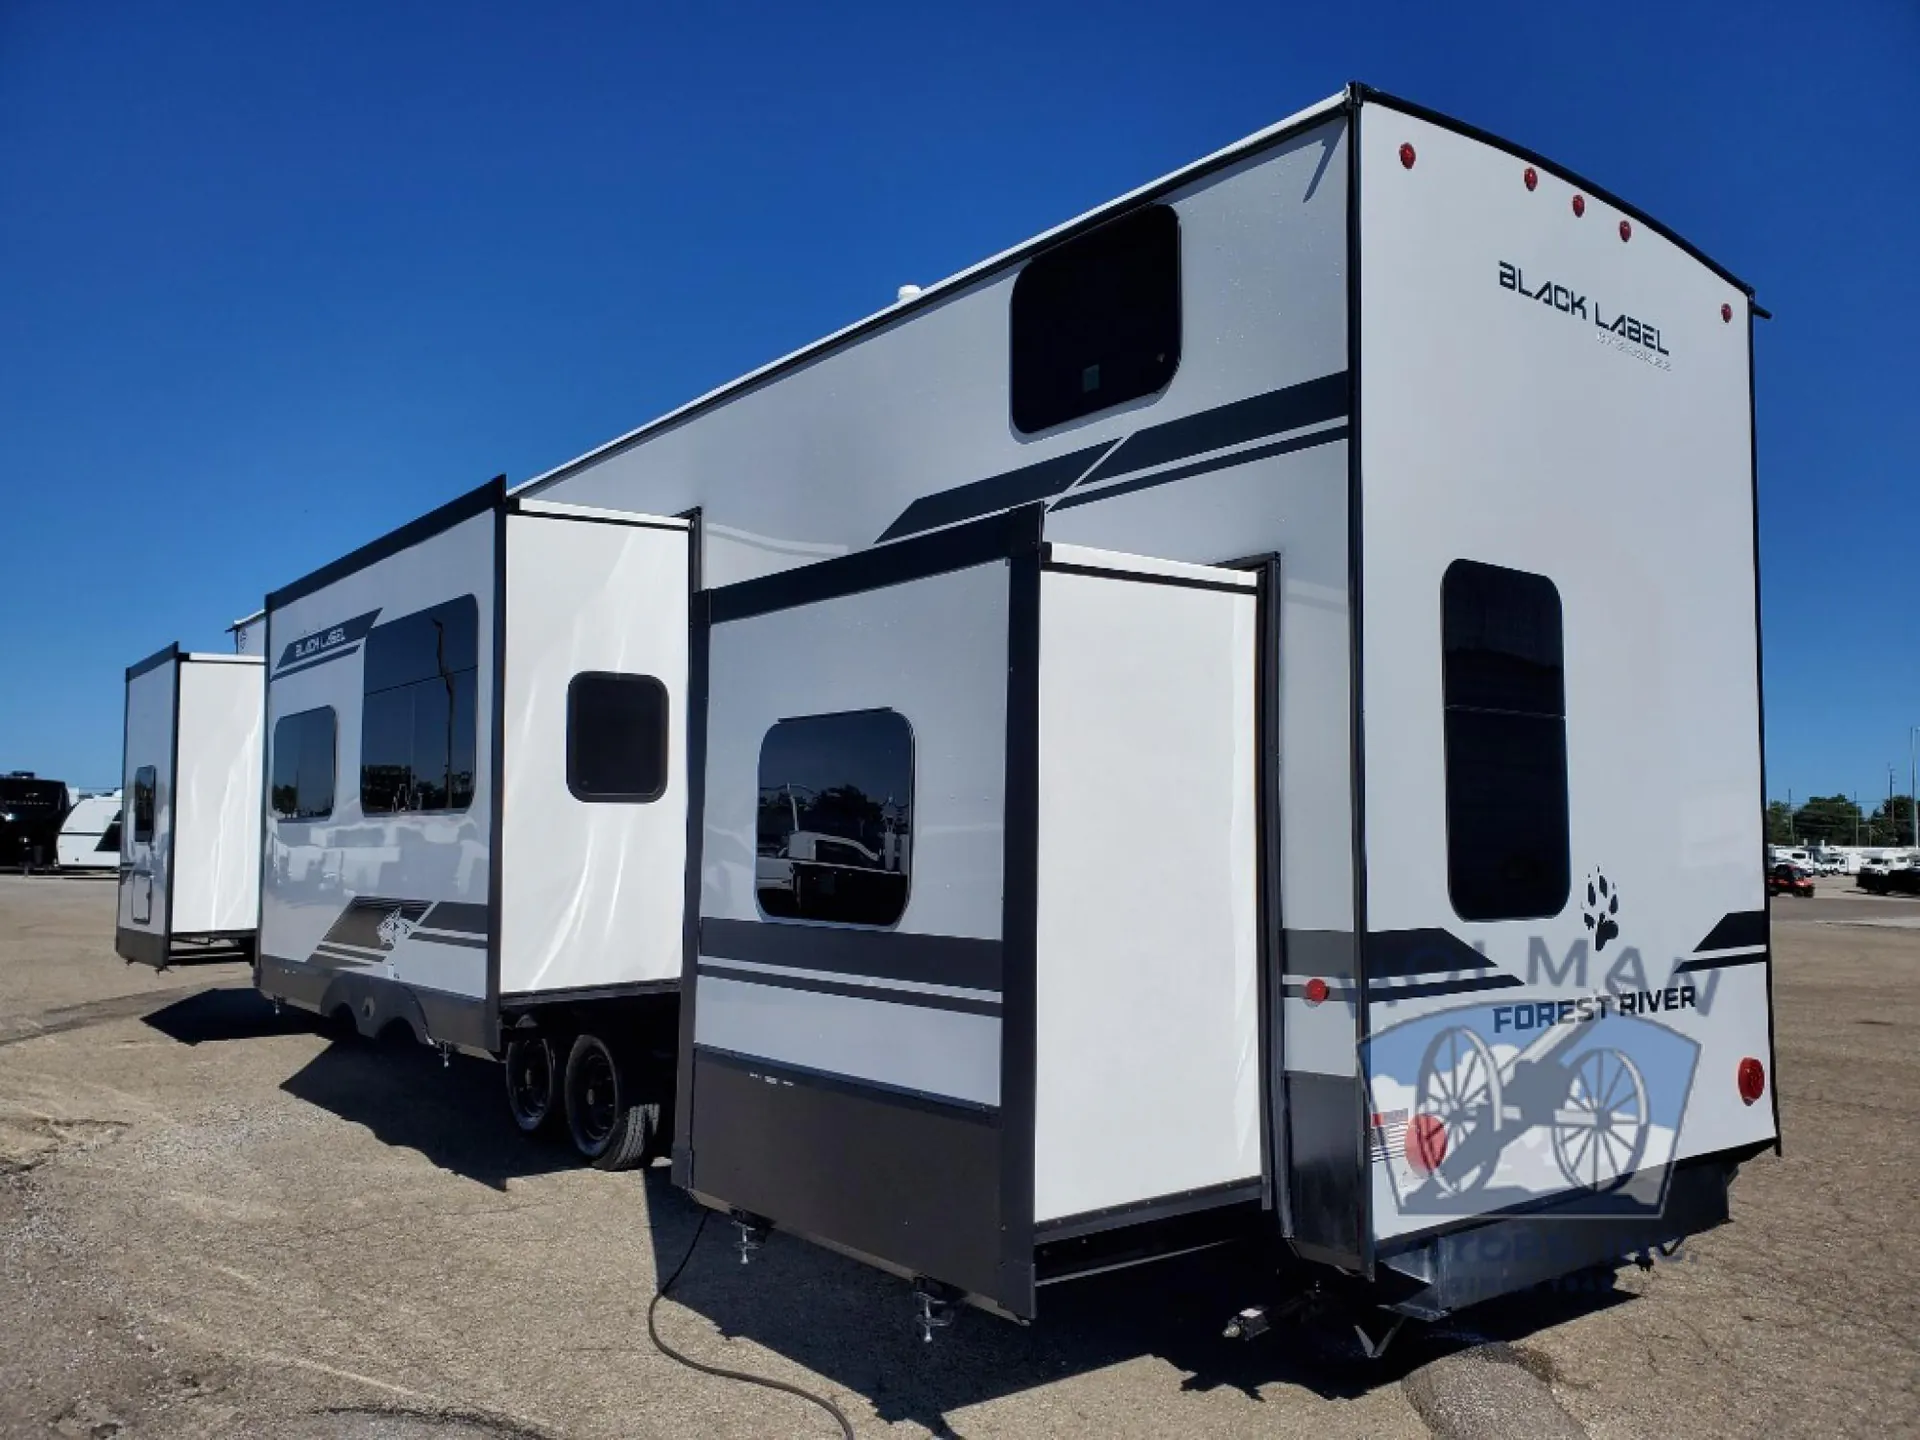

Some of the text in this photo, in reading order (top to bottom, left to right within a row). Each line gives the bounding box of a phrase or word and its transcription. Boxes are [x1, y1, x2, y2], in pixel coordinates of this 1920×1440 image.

[1498, 260, 1587, 321] BLACK
[1595, 301, 1670, 356] LABEL
[1491, 985, 1697, 1034] FOREST RIVER
